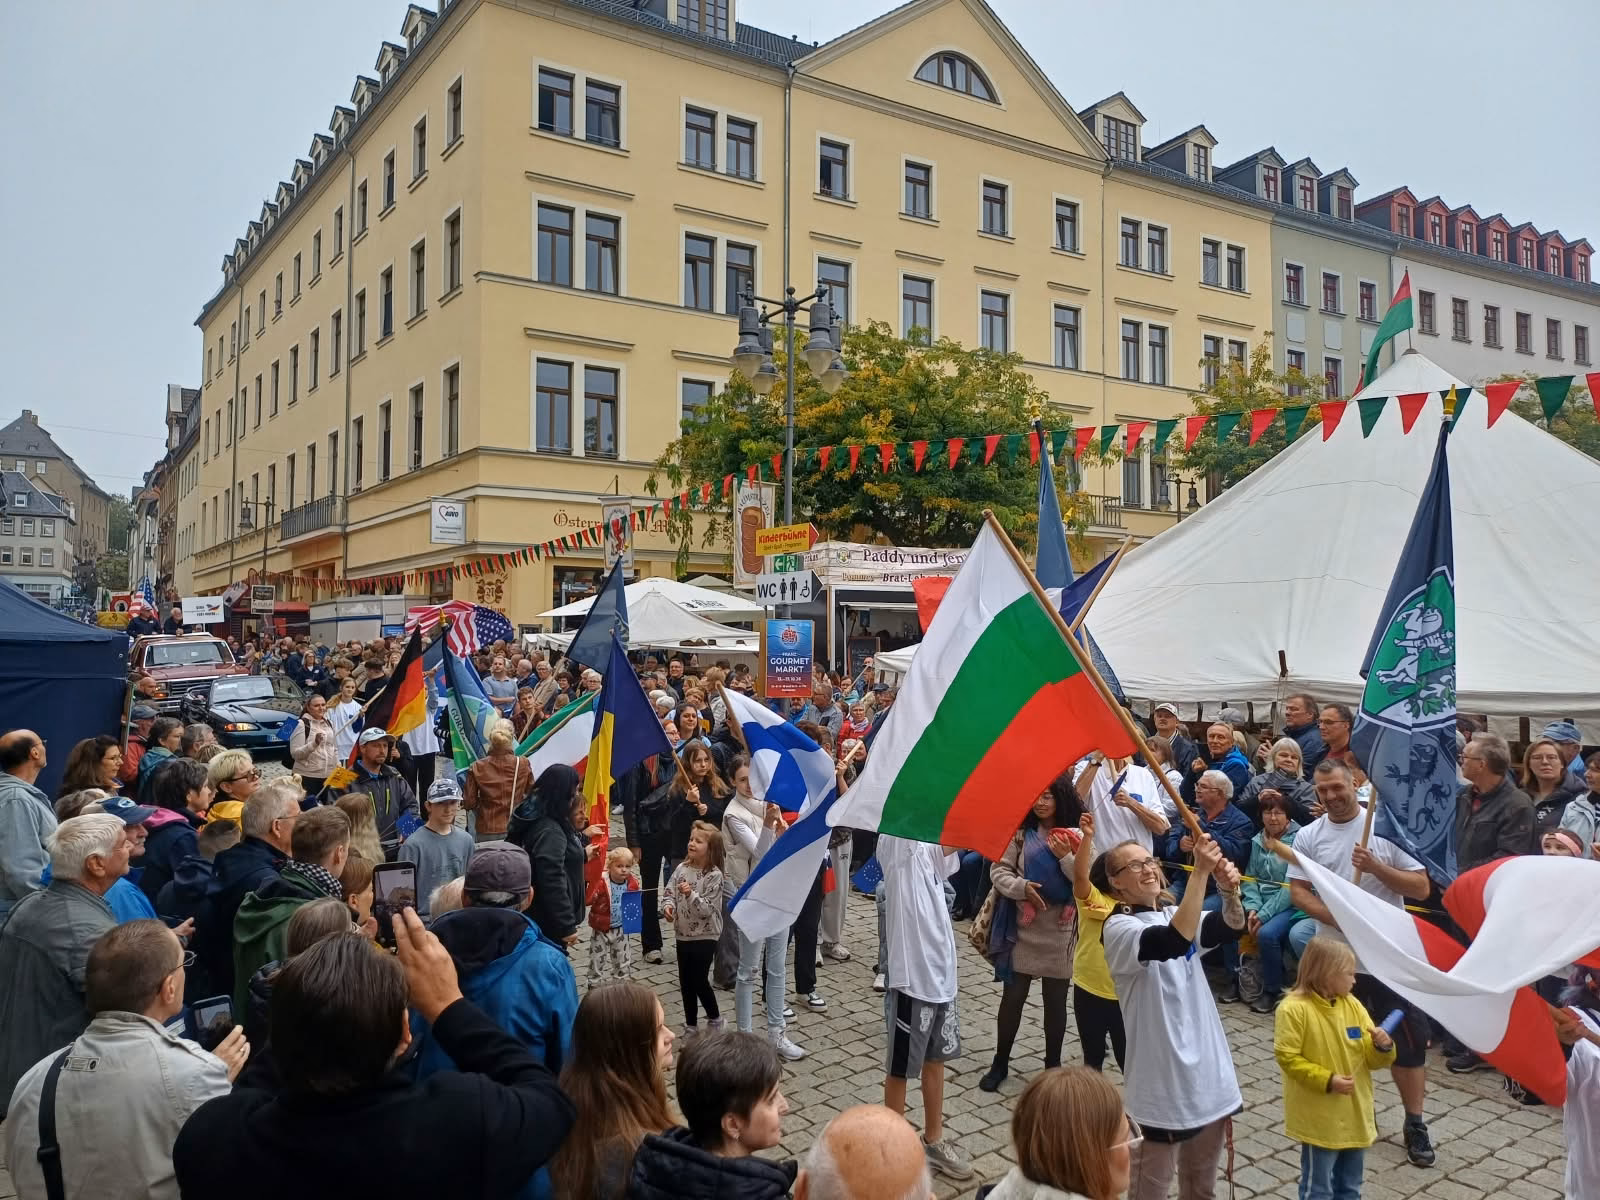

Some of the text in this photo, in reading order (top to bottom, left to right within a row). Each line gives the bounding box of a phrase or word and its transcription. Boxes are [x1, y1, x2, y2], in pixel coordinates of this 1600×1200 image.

[758, 529, 808, 545] Kinderbühne
[863, 549, 906, 566] Paddy
[911, 551, 938, 564] und
[757, 583, 777, 599] WC
[770, 657, 810, 665] GOURMET
[775, 665, 804, 673] MARKT
